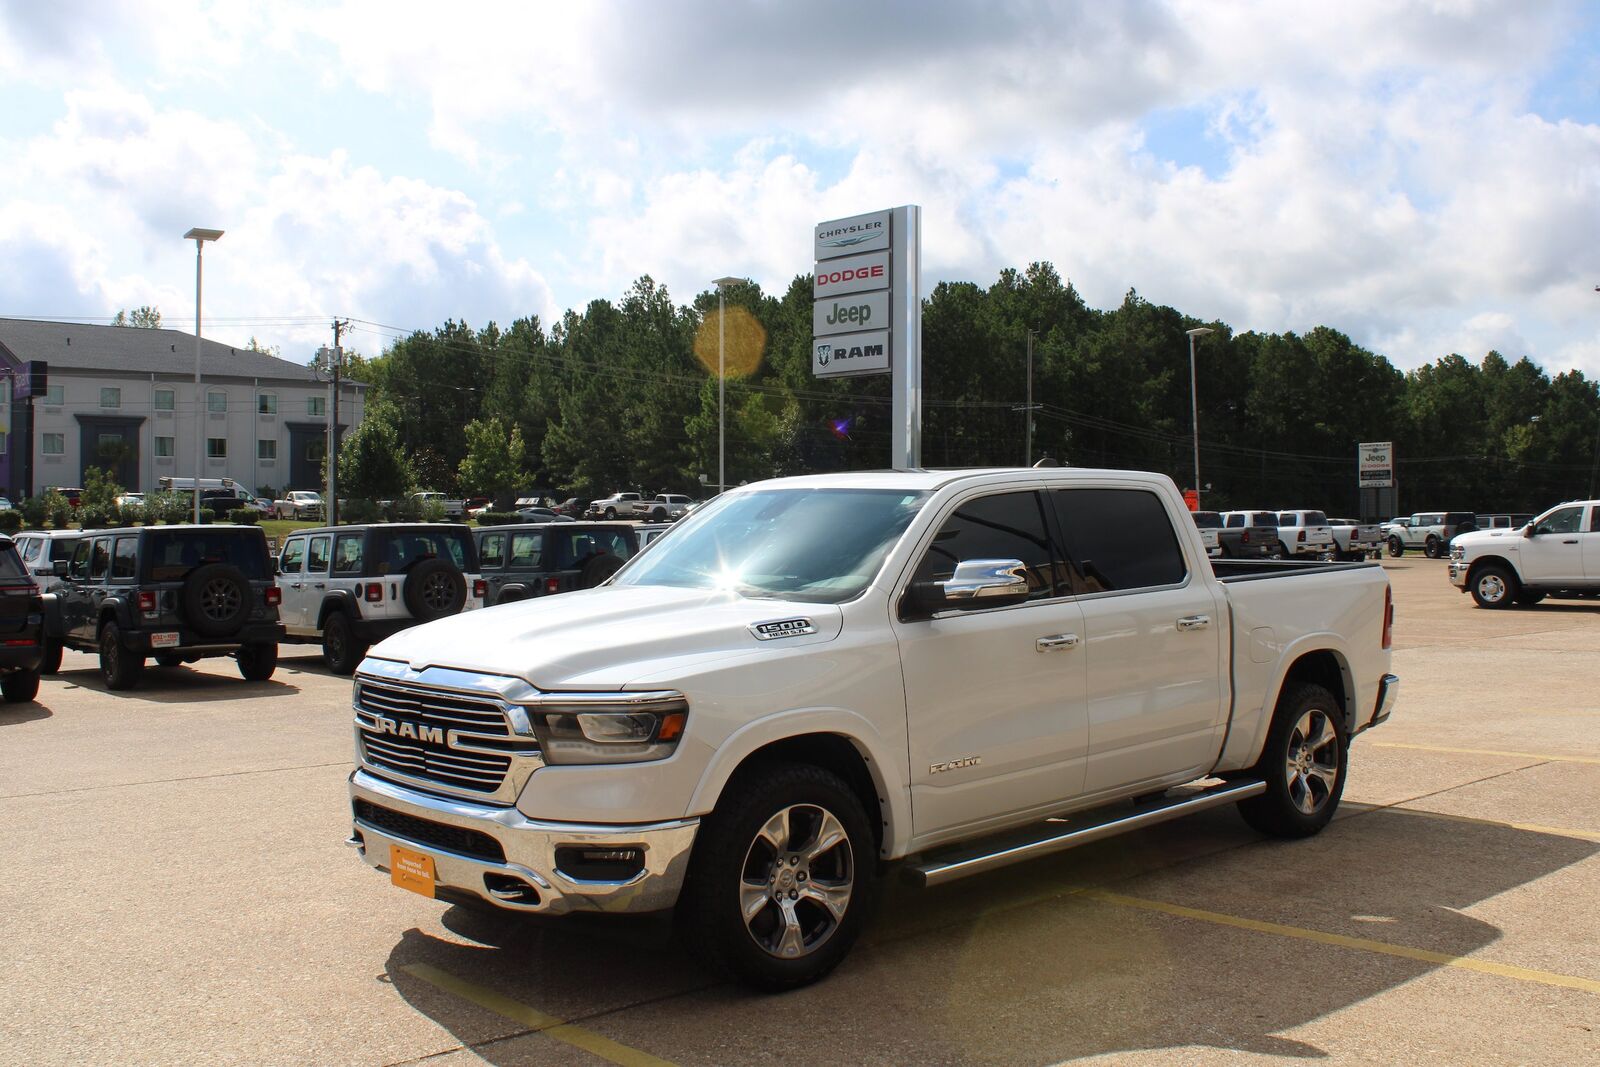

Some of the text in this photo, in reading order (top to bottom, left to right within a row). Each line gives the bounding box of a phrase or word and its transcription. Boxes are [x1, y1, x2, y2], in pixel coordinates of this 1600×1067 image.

[819, 221, 882, 239] CHRYSLER
[817, 265, 884, 286] DODGE
[826, 303, 871, 326] Jeep
[834, 344, 883, 360] RAM
[1365, 453, 1386, 462] Jeep
[760, 620, 806, 633] 1500
[378, 717, 443, 744] RAM
[929, 756, 981, 774] RAM
